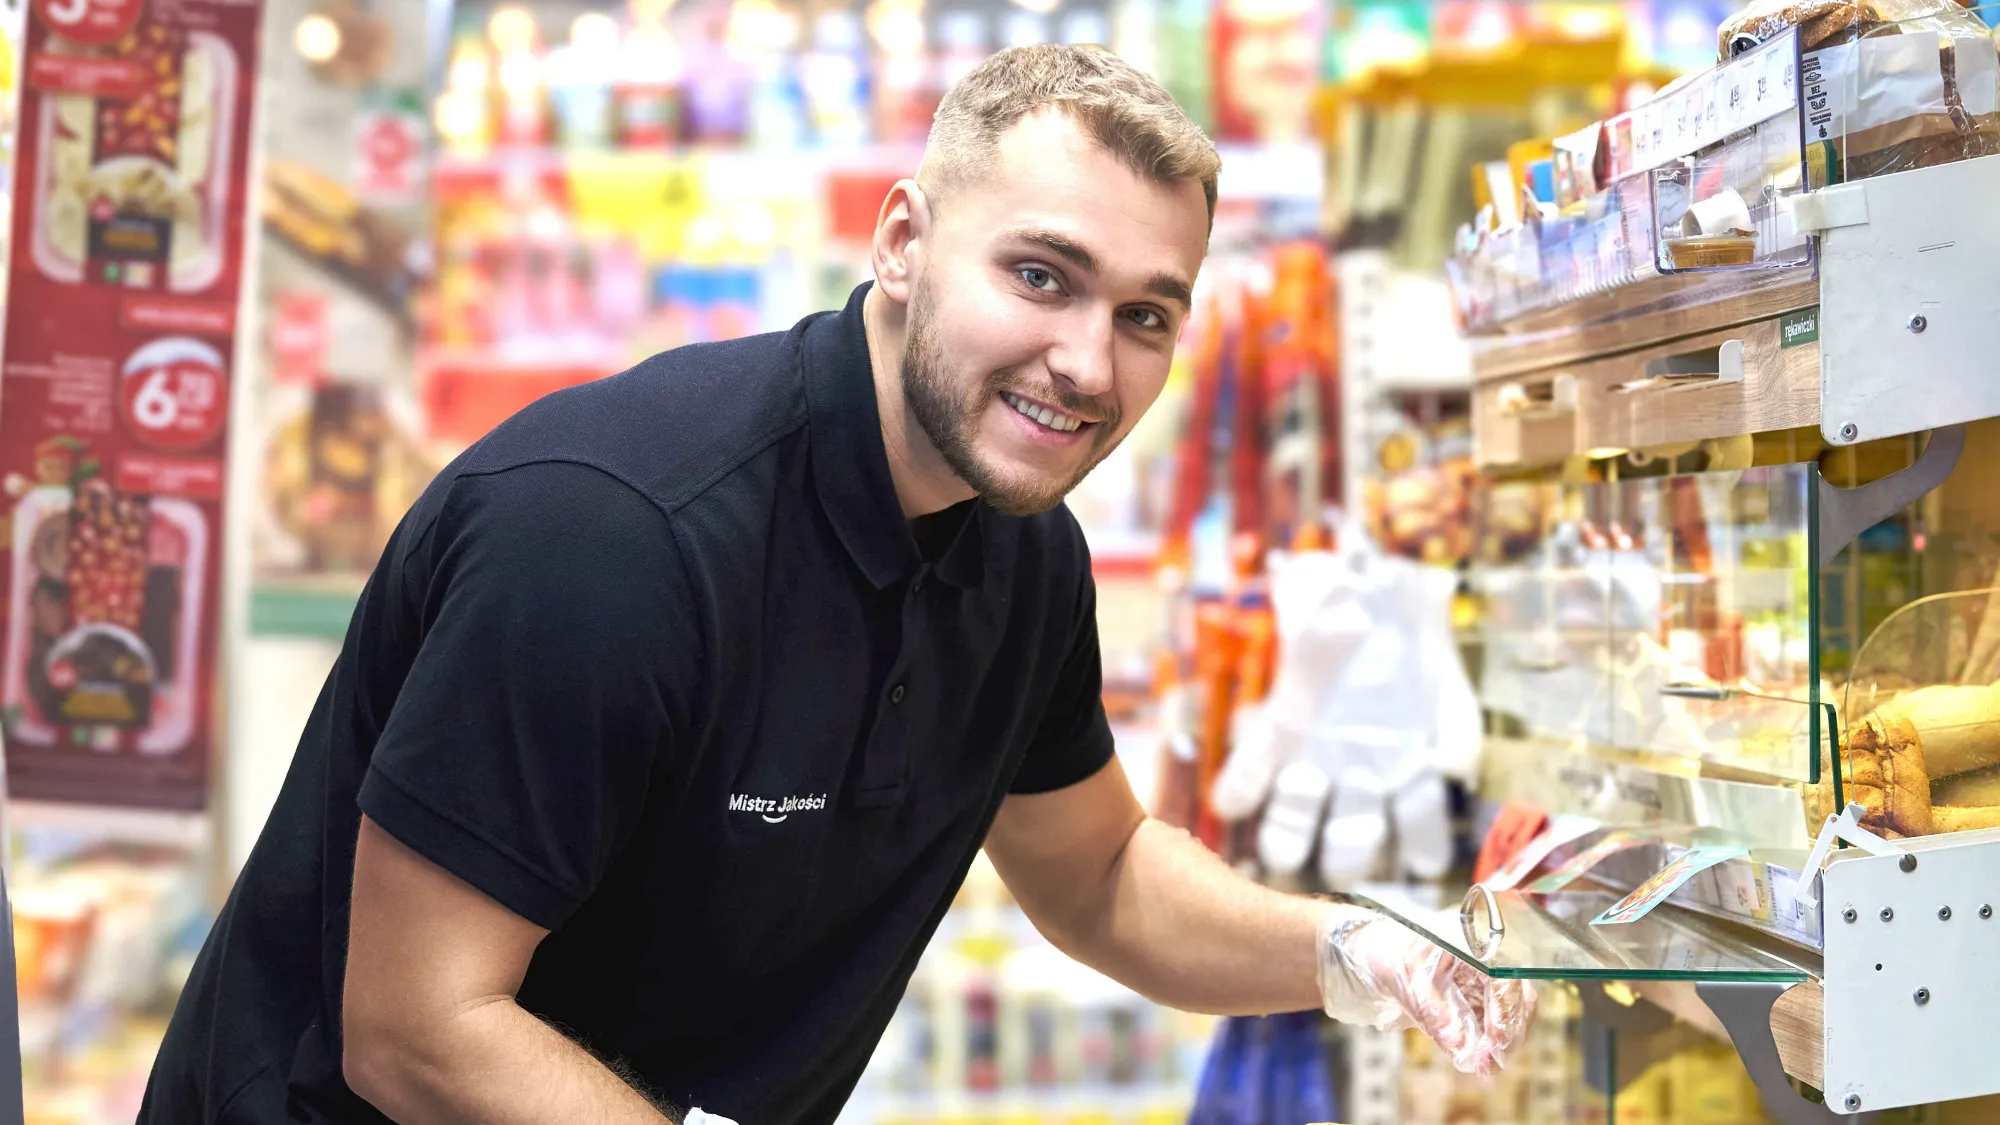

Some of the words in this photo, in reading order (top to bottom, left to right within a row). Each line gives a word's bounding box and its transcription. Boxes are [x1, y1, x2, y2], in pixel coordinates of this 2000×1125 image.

[1785, 314, 1815, 342] rękawiczki
[728, 793, 777, 812] Mistrz
[777, 792, 827, 812] Jakości
